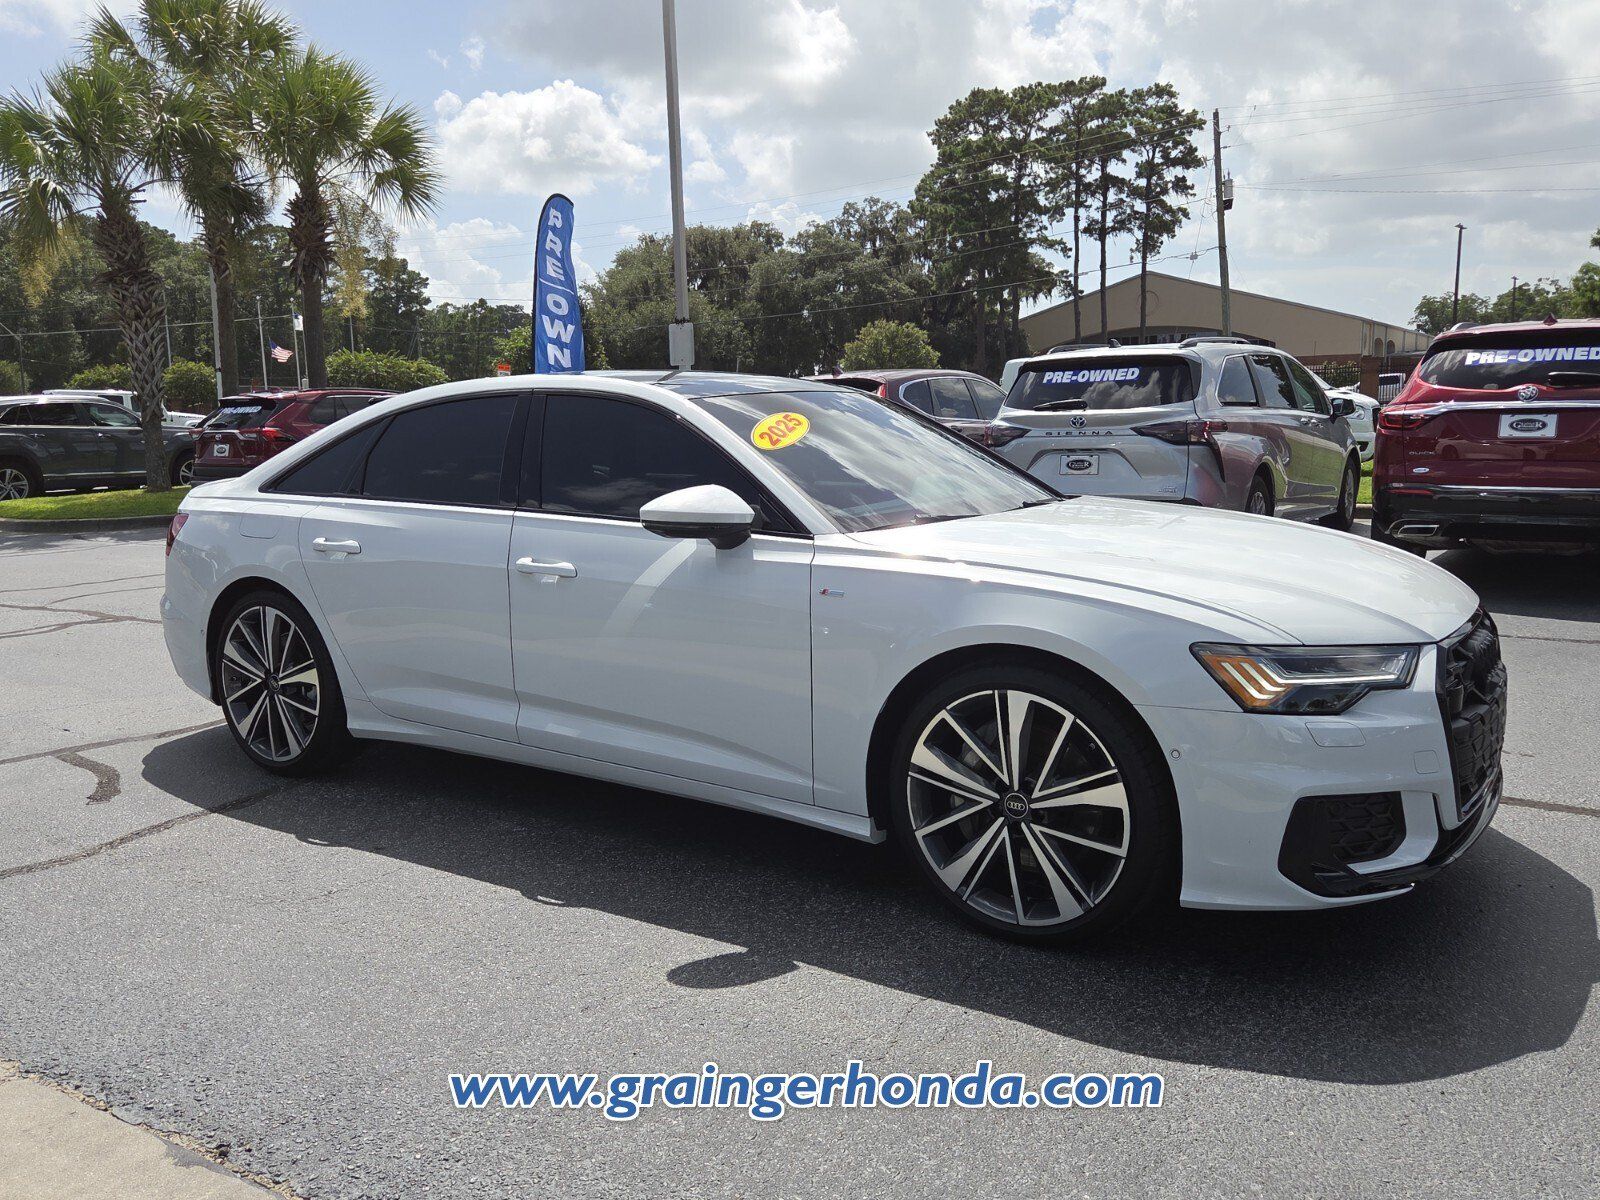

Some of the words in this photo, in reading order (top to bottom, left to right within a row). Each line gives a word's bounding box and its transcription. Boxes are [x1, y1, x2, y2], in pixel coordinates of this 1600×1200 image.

[1465, 346, 1600, 365] PRE-OWNED
[1042, 367, 1140, 384] PRE-OWNED
[758, 413, 803, 446] 2025
